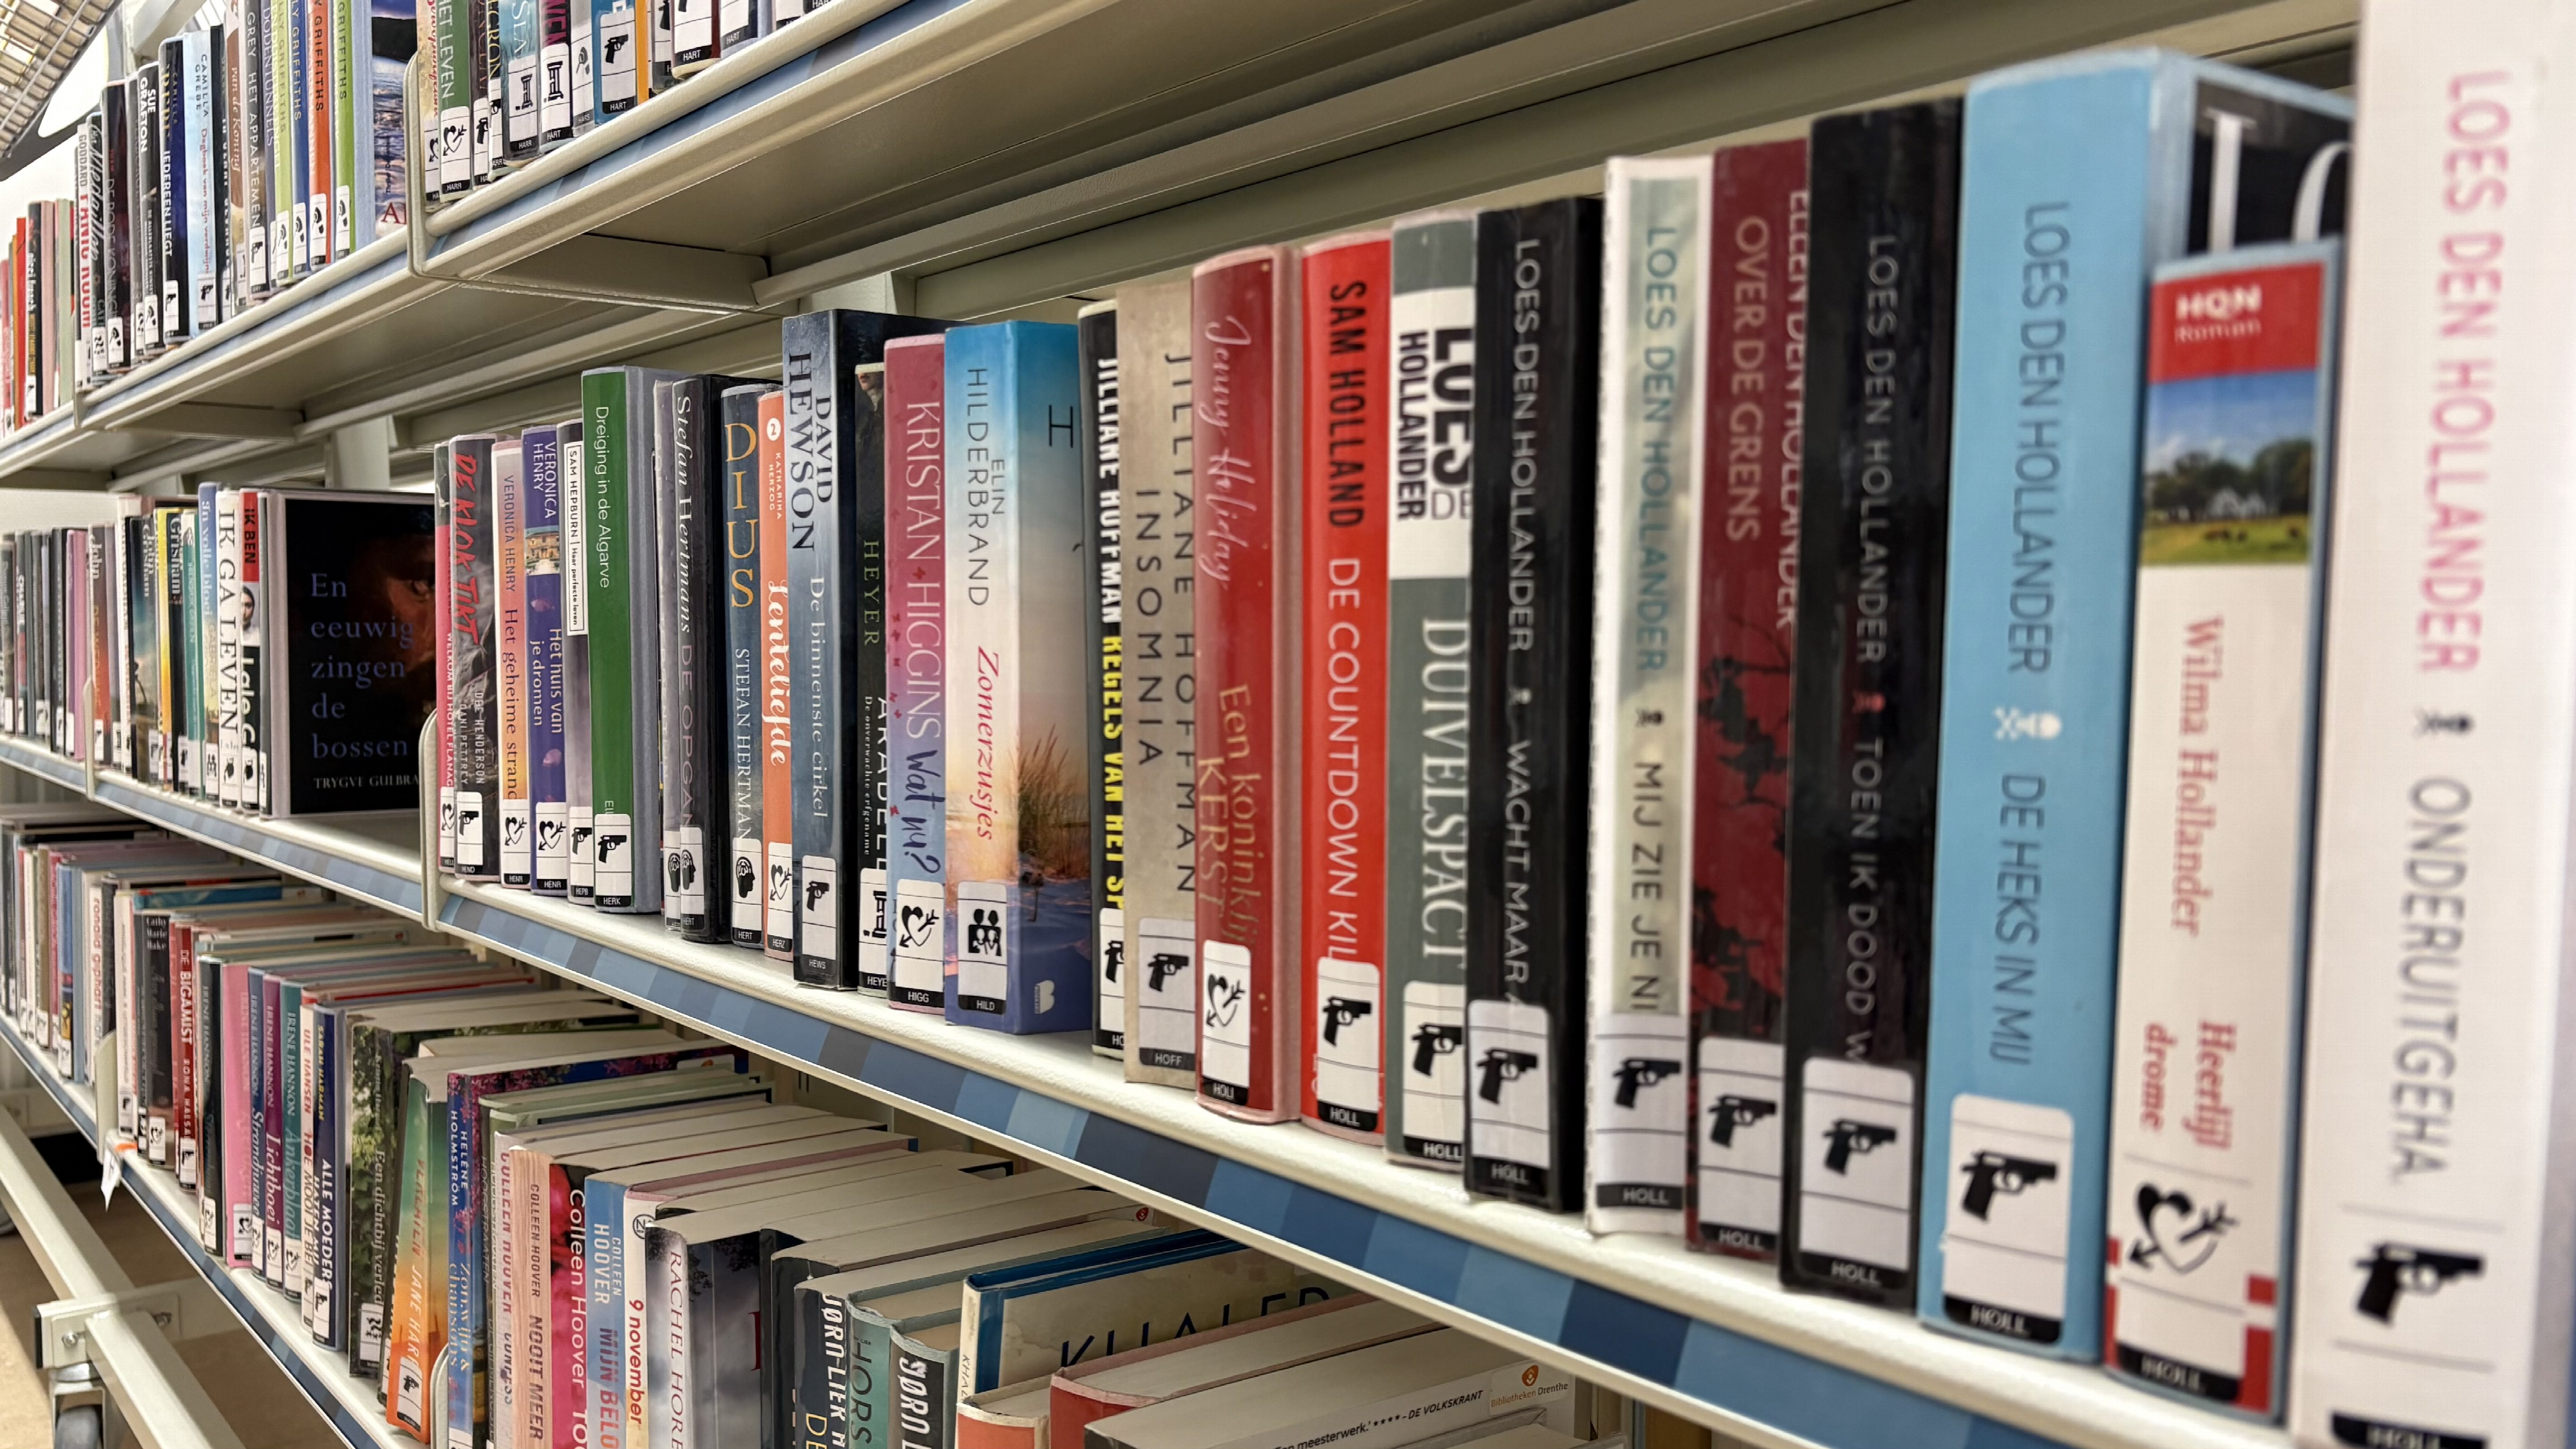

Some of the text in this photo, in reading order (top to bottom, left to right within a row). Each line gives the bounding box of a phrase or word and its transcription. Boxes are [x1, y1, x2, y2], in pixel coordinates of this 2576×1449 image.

[247, 12, 258, 104] GREY HET
[292, 26, 301, 121] GRIFFITHS
[314, 15, 324, 111] GRIFFITHS
[338, 1, 347, 100] GRIFFITHS
[440, 34, 455, 99] LEVEN
[683, 50, 701, 61] HART
[518, 140, 533, 149] HARR
[610, 101, 627, 111] HART
[446, 182, 462, 191] HARR
[164, 218, 173, 257] LIEGT
[1513, 236, 1541, 334] LOES
[2175, 283, 2262, 322] HQN
[1097, 357, 1120, 479] JILLIANE
[1512, 343, 1540, 421] DEN
[1726, 216, 1770, 543] OVER DE GRENS
[2416, 68, 2512, 674] LOES DEN HOLLANDER
[533, 443, 544, 491] HENRY
[788, 352, 816, 551] HEWSON
[815, 395, 833, 503] DAVID
[1198, 316, 1257, 590] Jenny Holiday
[1397, 330, 1429, 522] HOLLANDER
[544, 441, 557, 519] VERONICA
[570, 481, 578, 538] HEPBURN
[594, 405, 612, 589] Dreiging in de Algarve
[724, 422, 759, 608] DIUS
[967, 368, 990, 606] HILDERBRAND
[219, 509, 235, 549] IK
[244, 508, 256, 564] IK BEN
[454, 451, 480, 645] DE KLOK TIKT
[676, 395, 694, 691] Stefan Hertmans DE
[1508, 430, 1539, 652] HOLLANDER
[219, 560, 236, 603] GA
[311, 573, 347, 598] En
[502, 475, 520, 734] VERONICA HENRY Het geheime
[863, 541, 880, 646] HEYER
[1135, 489, 1164, 766] INSOMNIA
[1164, 353, 1196, 893] JILLIANE HOFFMAN
[1327, 280, 1367, 898] SAM HOLLAND DE COUNTDOWN
[1631, 226, 1677, 959] LOES DEN HOLLANDER MIJ ZIE JE
[1993, 198, 2072, 1000] LOES DEN HOLLANDER DE HEKS IN
[220, 616, 238, 733] LEVEN
[311, 616, 414, 650] eeuwig
[311, 656, 405, 689] zingen
[761, 578, 791, 767] Lenteliefde
[901, 401, 947, 876] KRISTAN HIGGINS Wat nu?
[969, 459, 1005, 841] ELIN Zomerzusjes
[241, 658, 255, 715] Lale
[312, 693, 345, 719] de
[530, 639, 546, 726] je dromen
[549, 629, 563, 734] Het huis van
[735, 648, 751, 729] STEFAN
[810, 578, 829, 819] De binnenste cirkel
[1218, 684, 1252, 760] Een
[313, 733, 408, 759] bossen
[460, 735, 469, 784] PETTREY
[475, 716, 486, 784] HENDERSON
[863, 715, 873, 856] onverwachte erfgename
[1421, 616, 1471, 969] DUIVELSPACT
[1851, 738, 1886, 840] TOEN
[2170, 614, 2225, 938] Wilma Hollander
[1504, 739, 1532, 874] WACHT
[544, 880, 561, 889] HENR
[603, 897, 621, 905] HERK
[1848, 852, 1879, 893] IK
[737, 931, 753, 941] HERT
[772, 938, 786, 949] HERZ
[808, 958, 826, 969] HEWS
[1503, 882, 1531, 985] MAAR
[1845, 903, 1879, 1016] DOOD
[180, 950, 193, 1045] DE BIGAMIST
[907, 991, 929, 1003] HIGG
[976, 999, 995, 1011] HILD
[287, 1012, 297, 1117] IRENE HANNON
[303, 1056, 313, 1113] HANSEN
[1155, 1052, 1182, 1066] HOFF
[450, 1110, 459, 1206] HOLMSTRÖM
[460, 1131, 469, 1189] HELÉNE
[1329, 1106, 1360, 1127] HOLL
[265, 1131, 281, 1225] Lichtboei
[321, 1158, 333, 1201] ALLE
[372, 1150, 386, 1249] Een dichtbij
[1491, 1163, 1530, 1185] HOLL
[408, 1264, 423, 1315] JANE
[529, 1184, 544, 1441] COLLEEN HOOVER NOOIT MEER
[569, 1189, 587, 1388] Colleen Hoover
[594, 1224, 619, 1383] HOOVER MIJN
[612, 1236, 621, 1297] COLLEEN
[670, 1251, 683, 1359] RACHEL
[627, 1300, 645, 1425] 9 november
[1423, 1390, 1484, 1415] VOLKSKRANT
[1490, 1381, 1569, 1408] Bibliotheken Drenthe
